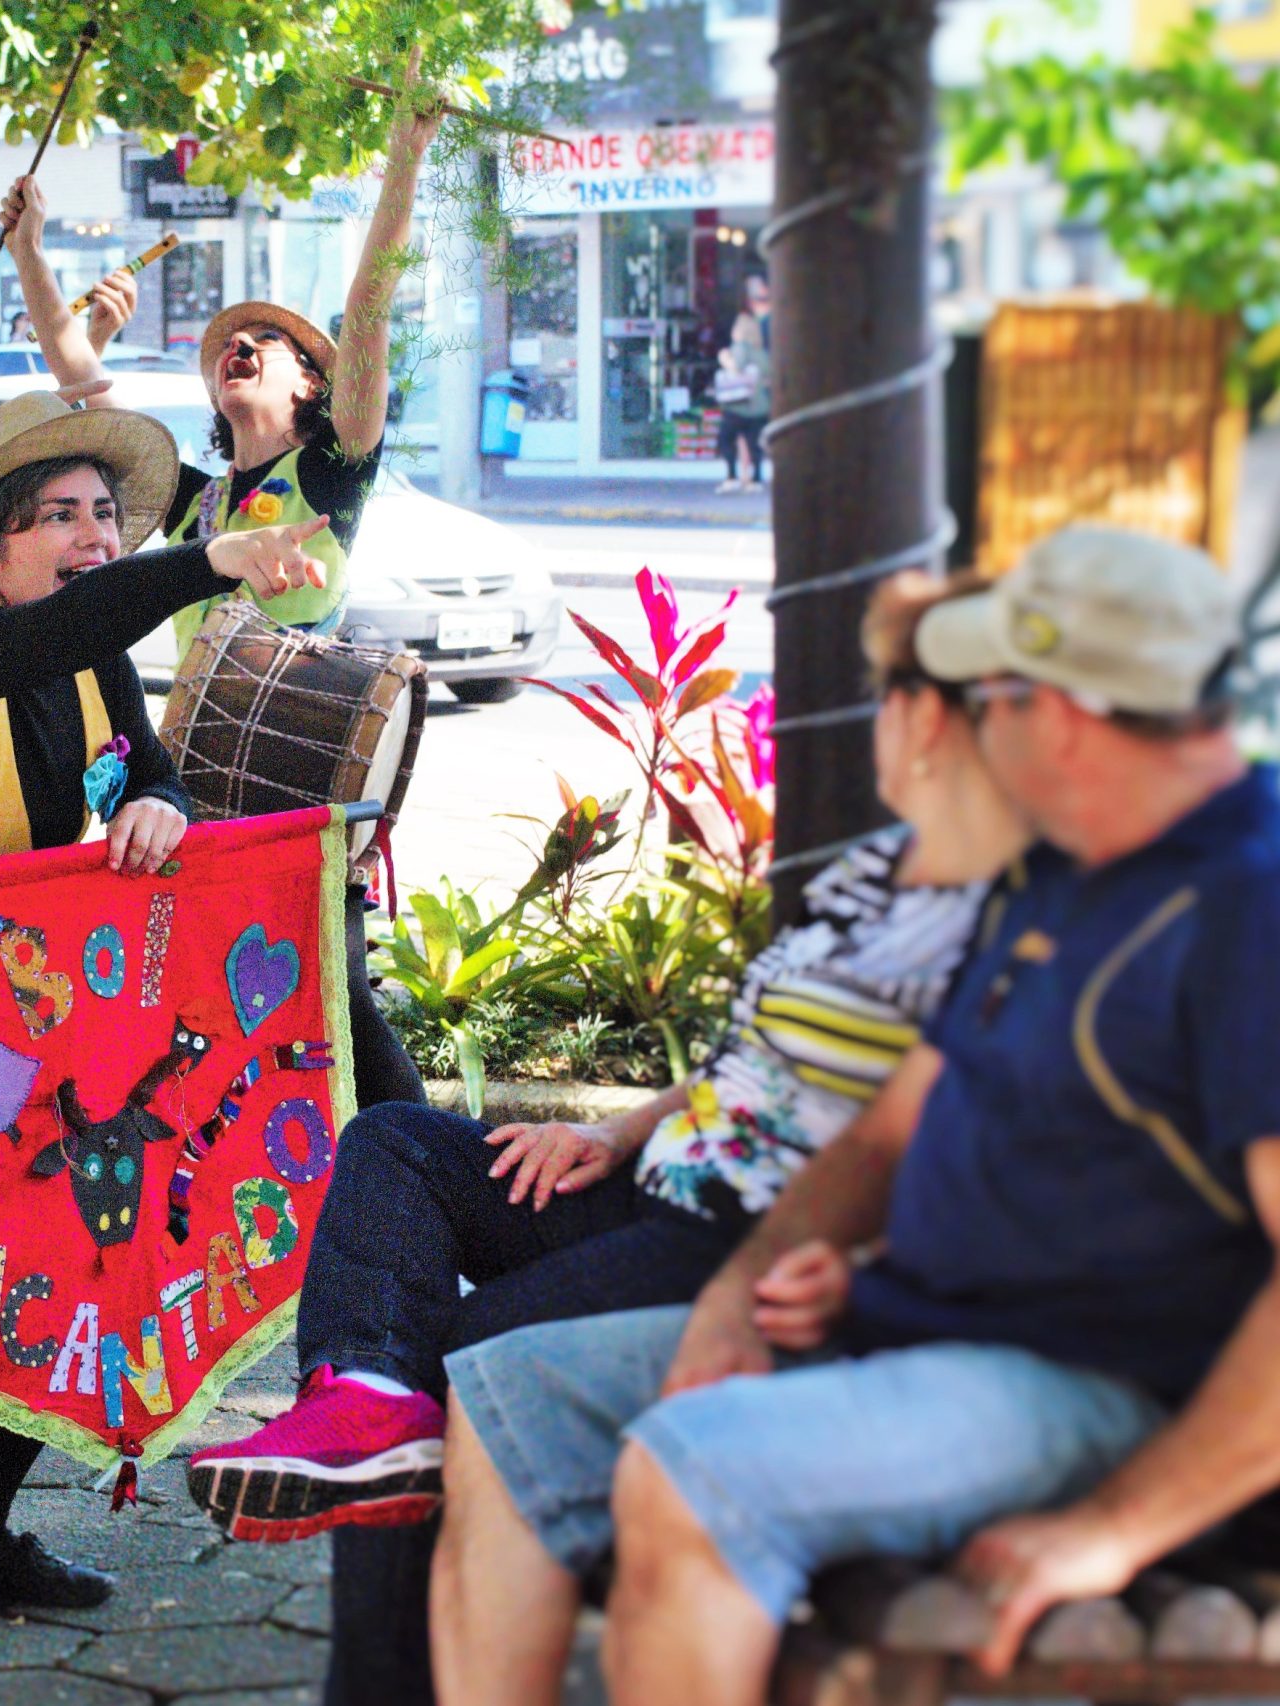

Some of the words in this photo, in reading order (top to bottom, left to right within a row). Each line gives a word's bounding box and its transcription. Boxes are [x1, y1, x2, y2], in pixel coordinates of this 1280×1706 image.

[511, 134, 621, 173] GRANDE
[637, 128, 774, 168] QUEIMAD
[576, 175, 716, 205] INVERNO
